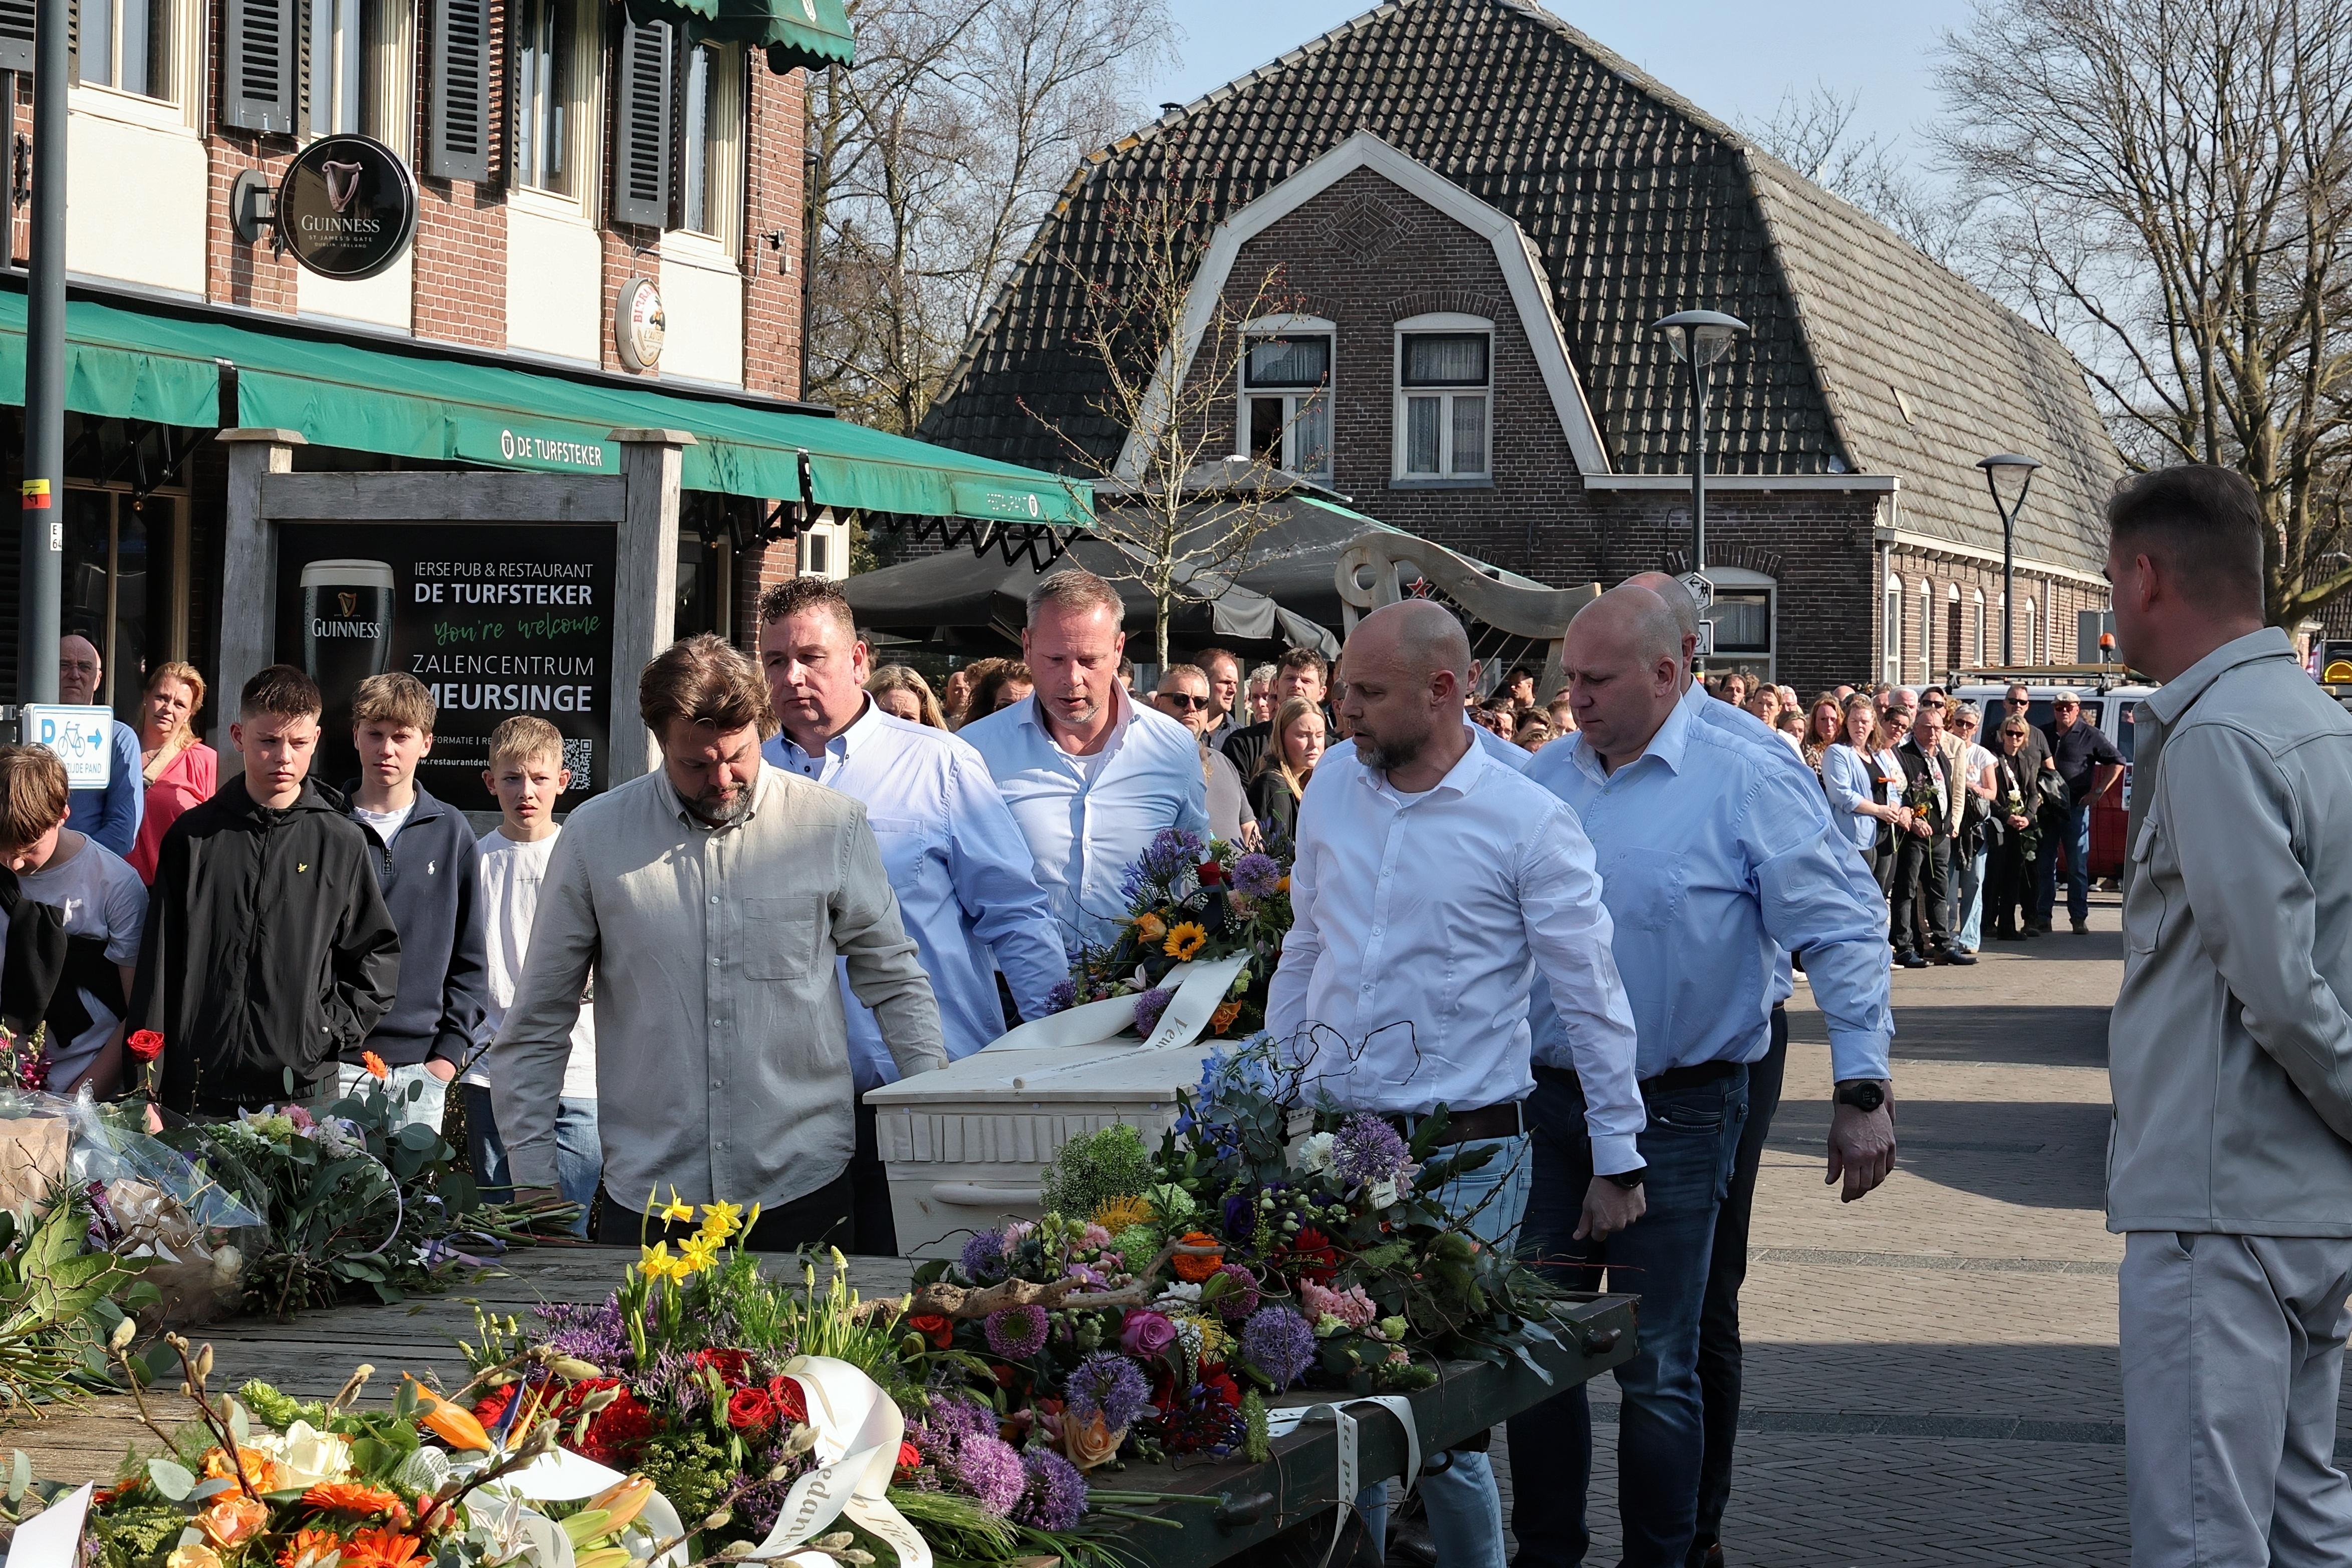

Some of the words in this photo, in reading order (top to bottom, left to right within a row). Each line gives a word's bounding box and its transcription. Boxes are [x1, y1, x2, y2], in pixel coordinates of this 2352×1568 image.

[301, 214, 380, 233] GUINNESS
[517, 436, 532, 457] DE
[535, 439, 602, 466] TURFSTEKER
[415, 562, 451, 576] IERSE
[454, 563, 481, 577] PUB
[484, 563, 495, 577] &
[499, 563, 594, 578] RESTAURANT
[415, 583, 444, 603] DE
[451, 584, 593, 605] TURFSTEKER
[312, 618, 381, 639] GUINNESS
[517, 612, 601, 640] welcome
[413, 654, 594, 676] ZALENCENTRUM
[432, 736, 473, 745] FORMATIE
[85, 763, 102, 774] PAND
